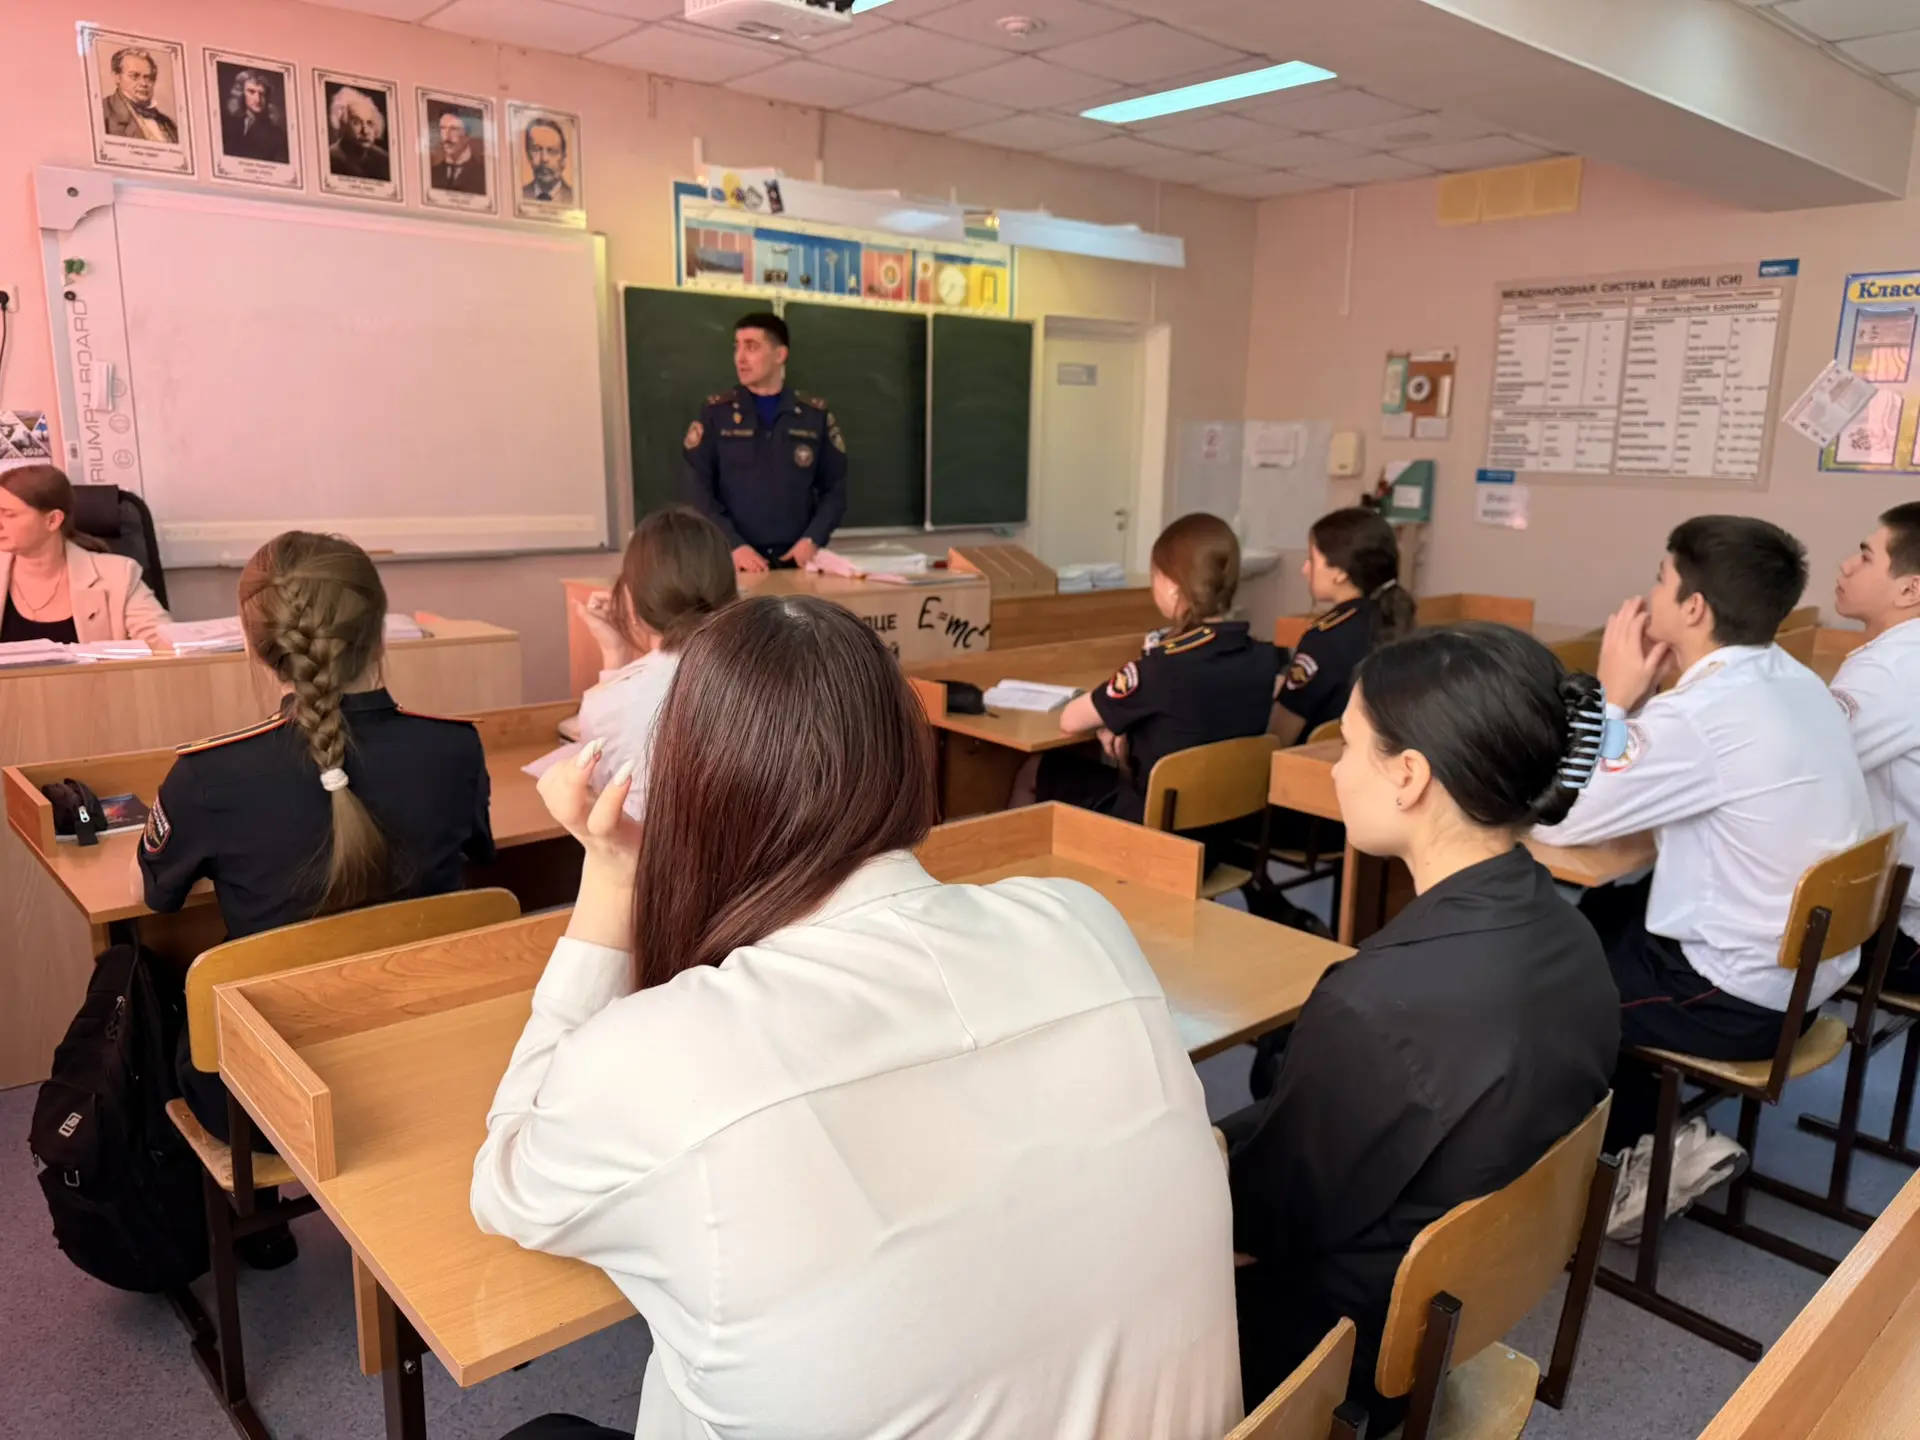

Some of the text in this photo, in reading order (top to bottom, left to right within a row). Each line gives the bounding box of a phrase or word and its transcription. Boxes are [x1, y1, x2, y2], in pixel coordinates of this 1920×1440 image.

[1601, 280, 1656, 294] СИСТЕМА
[1661, 276, 1711, 290] ЕДИНИЦ
[82, 392, 105, 483] RIUMPH
